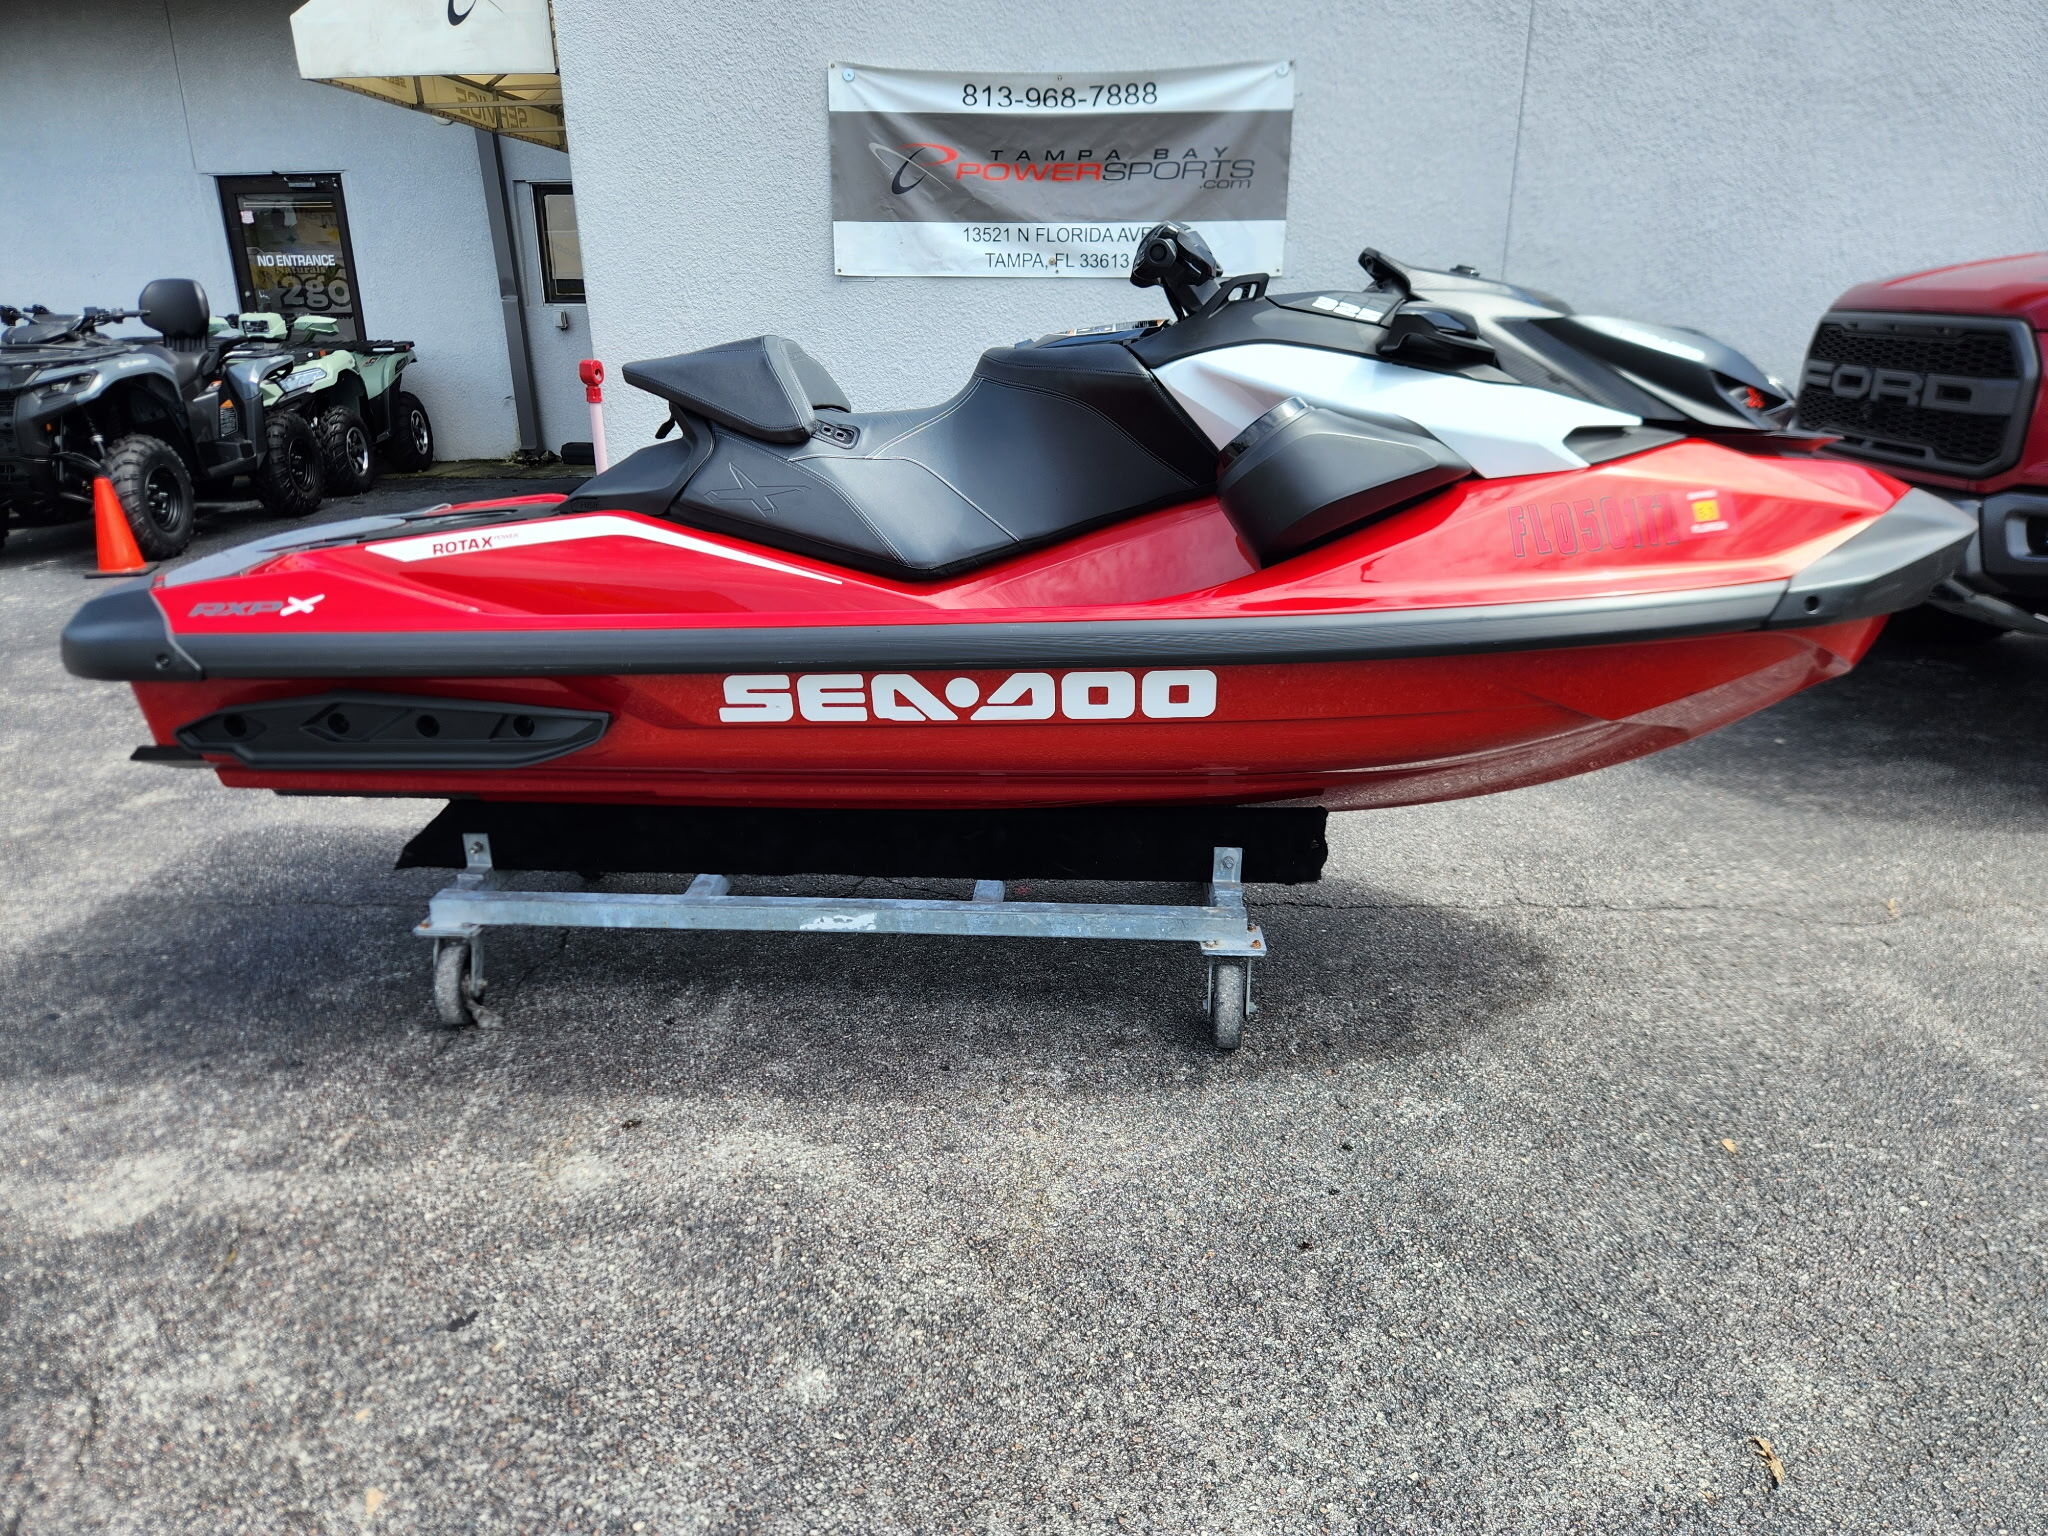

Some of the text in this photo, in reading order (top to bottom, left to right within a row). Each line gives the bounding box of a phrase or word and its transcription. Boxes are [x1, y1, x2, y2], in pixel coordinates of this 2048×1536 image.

[962, 81, 1158, 108] 813-968-7888
[991, 146, 1230, 162] TAMPA BAY
[955, 158, 1254, 182] POWERSPORTS
[1200, 179, 1251, 190] .com
[963, 226, 1012, 243] 13521
[1018, 226, 1030, 243] N
[1035, 226, 1115, 243] FLORIDA
[257, 255, 335, 266] NO ENTRANCE
[985, 253, 1130, 270] TAMPA, FL 33613
[1803, 359, 1990, 414] FORD
[432, 536, 493, 555] ROTAX
